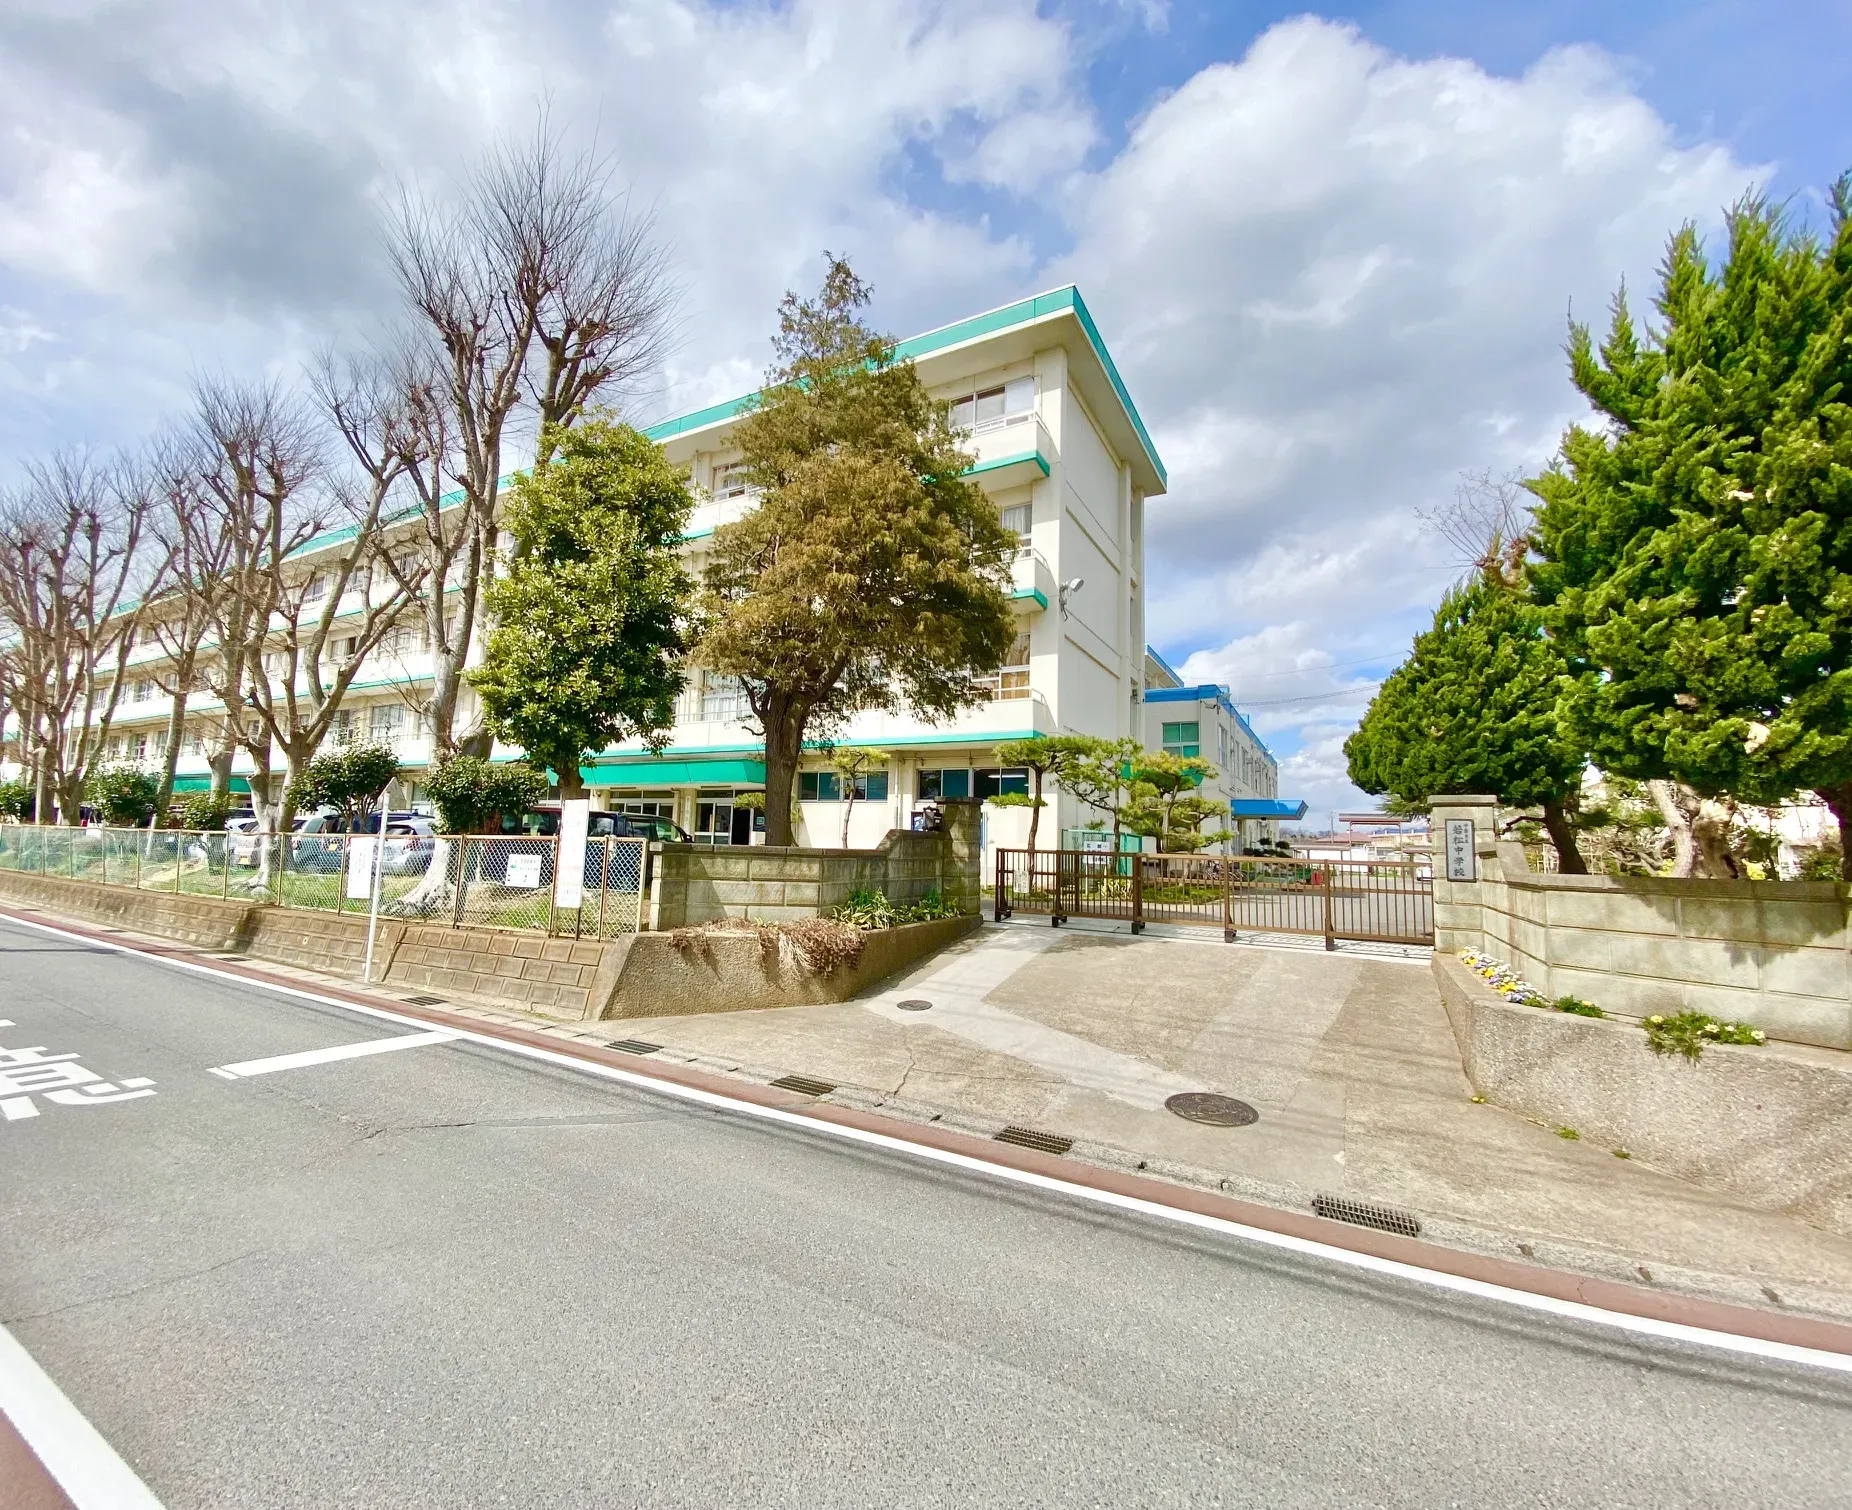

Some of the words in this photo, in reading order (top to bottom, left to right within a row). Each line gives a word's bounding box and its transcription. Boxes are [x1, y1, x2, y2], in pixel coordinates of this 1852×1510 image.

[1452, 825, 1465, 876] 若松中学校
